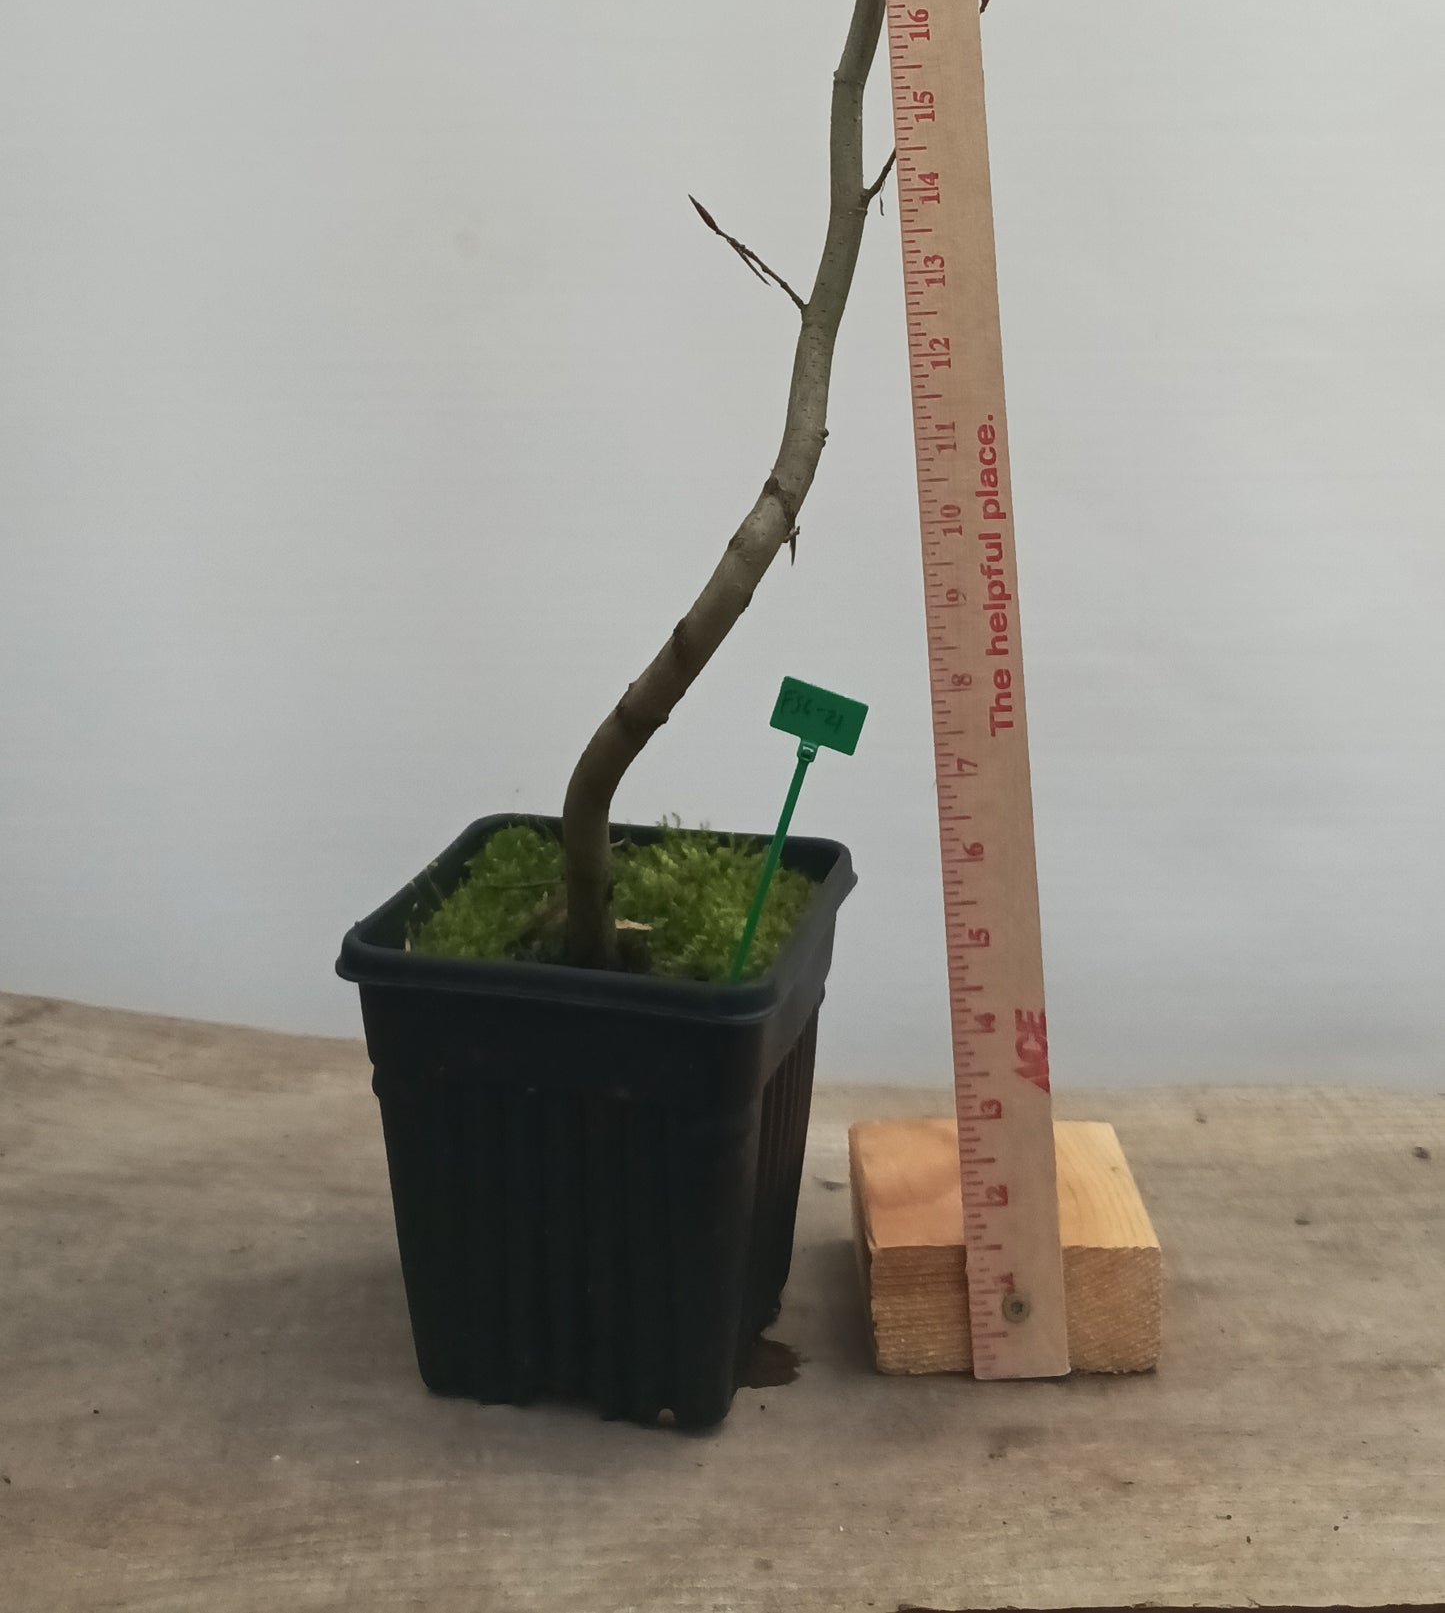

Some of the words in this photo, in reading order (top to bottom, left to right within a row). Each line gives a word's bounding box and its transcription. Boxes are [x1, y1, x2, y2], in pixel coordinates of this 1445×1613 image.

[907, 8, 930, 41] 16
[912, 90, 935, 123] 15
[917, 171, 941, 204] 14
[923, 254, 946, 287] 13
[928, 337, 951, 370] 12
[934, 421, 957, 454] 11
[975, 414, 1007, 520] place.
[940, 504, 963, 537] 10
[946, 588, 967, 602] 9
[978, 532, 1012, 656] helpful
[951, 673, 972, 686] 8
[989, 668, 1014, 737] The
[956, 757, 978, 772] 7
[962, 842, 984, 857] 6
[968, 928, 990, 945] 5
[1013, 1008, 1050, 1093] ACE
